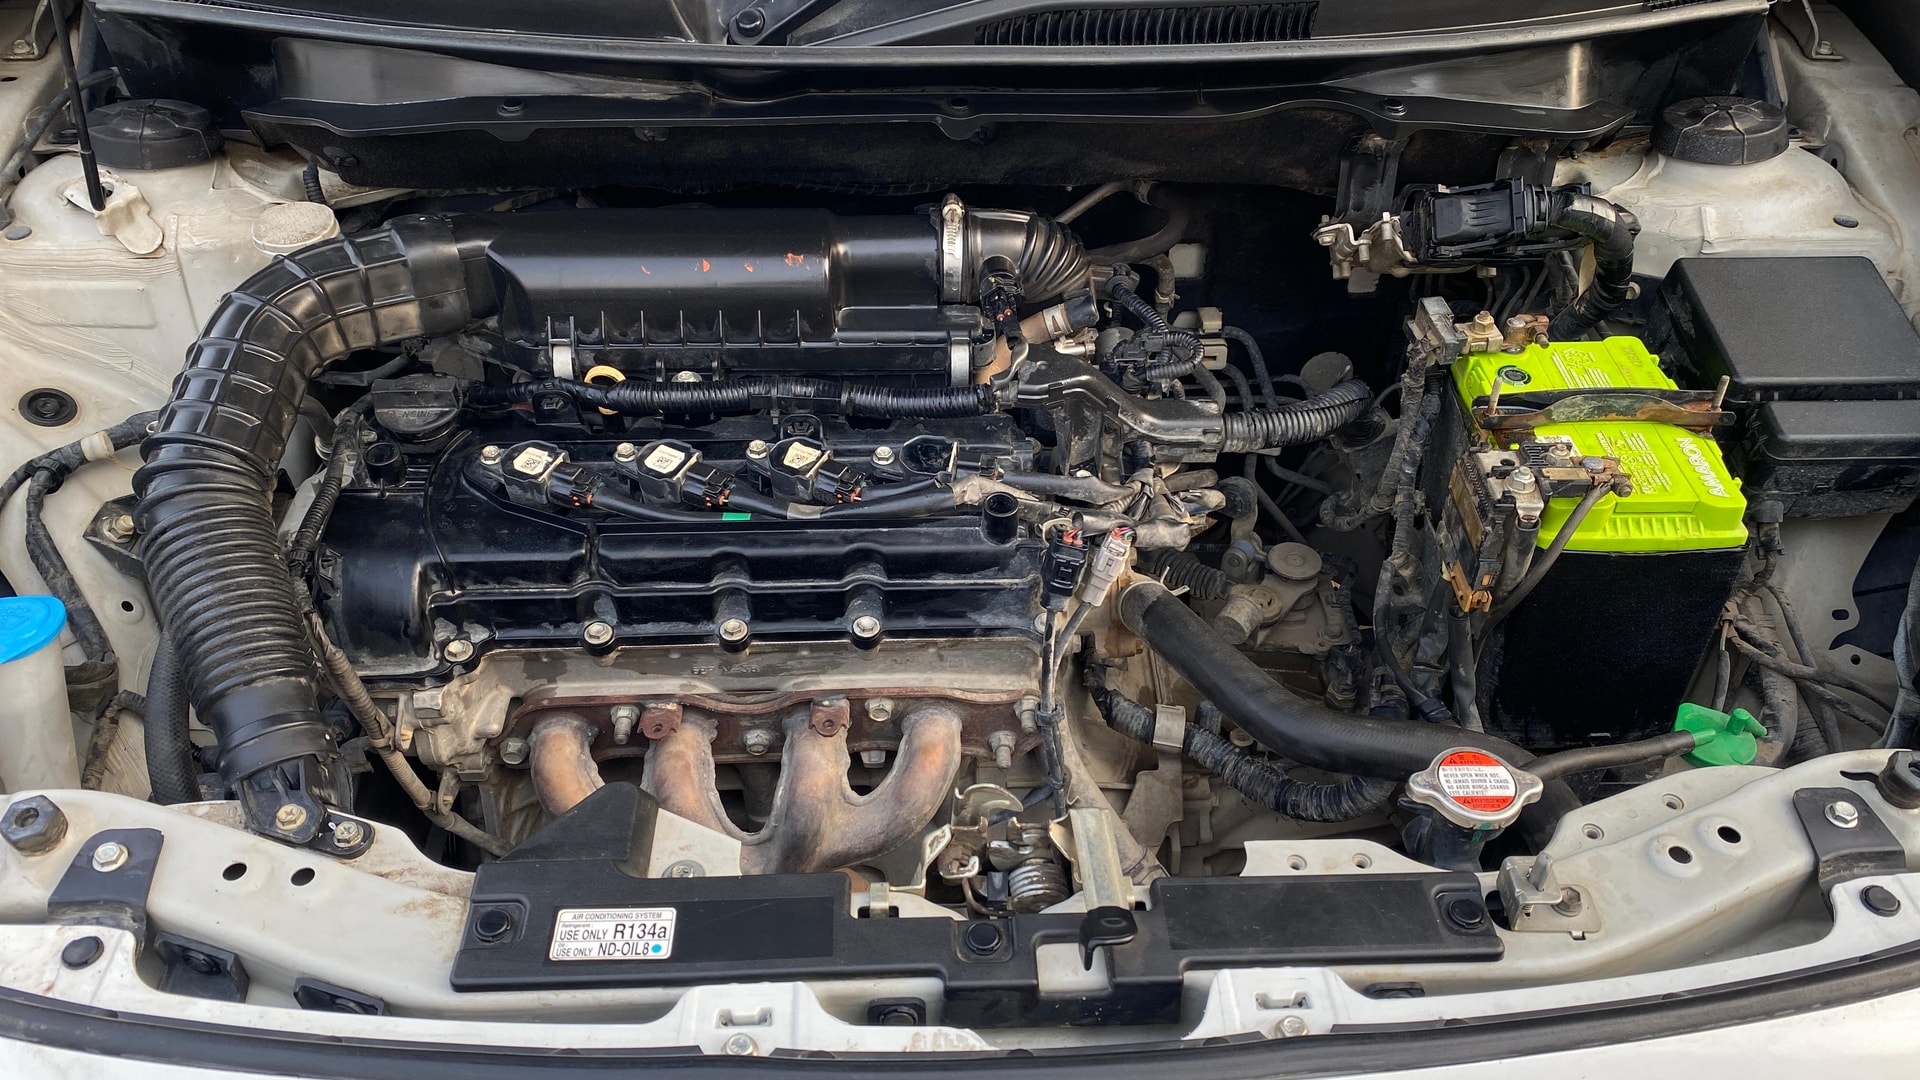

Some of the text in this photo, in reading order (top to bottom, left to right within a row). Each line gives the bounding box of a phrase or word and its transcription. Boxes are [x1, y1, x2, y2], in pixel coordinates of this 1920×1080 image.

[1676, 437, 1730, 497] AMARON
[585, 912, 634, 920] CONDITIONING
[559, 923, 667, 940] USE ONLY R134a
[556, 942, 650, 956] USE ONLY ND-OIL8
